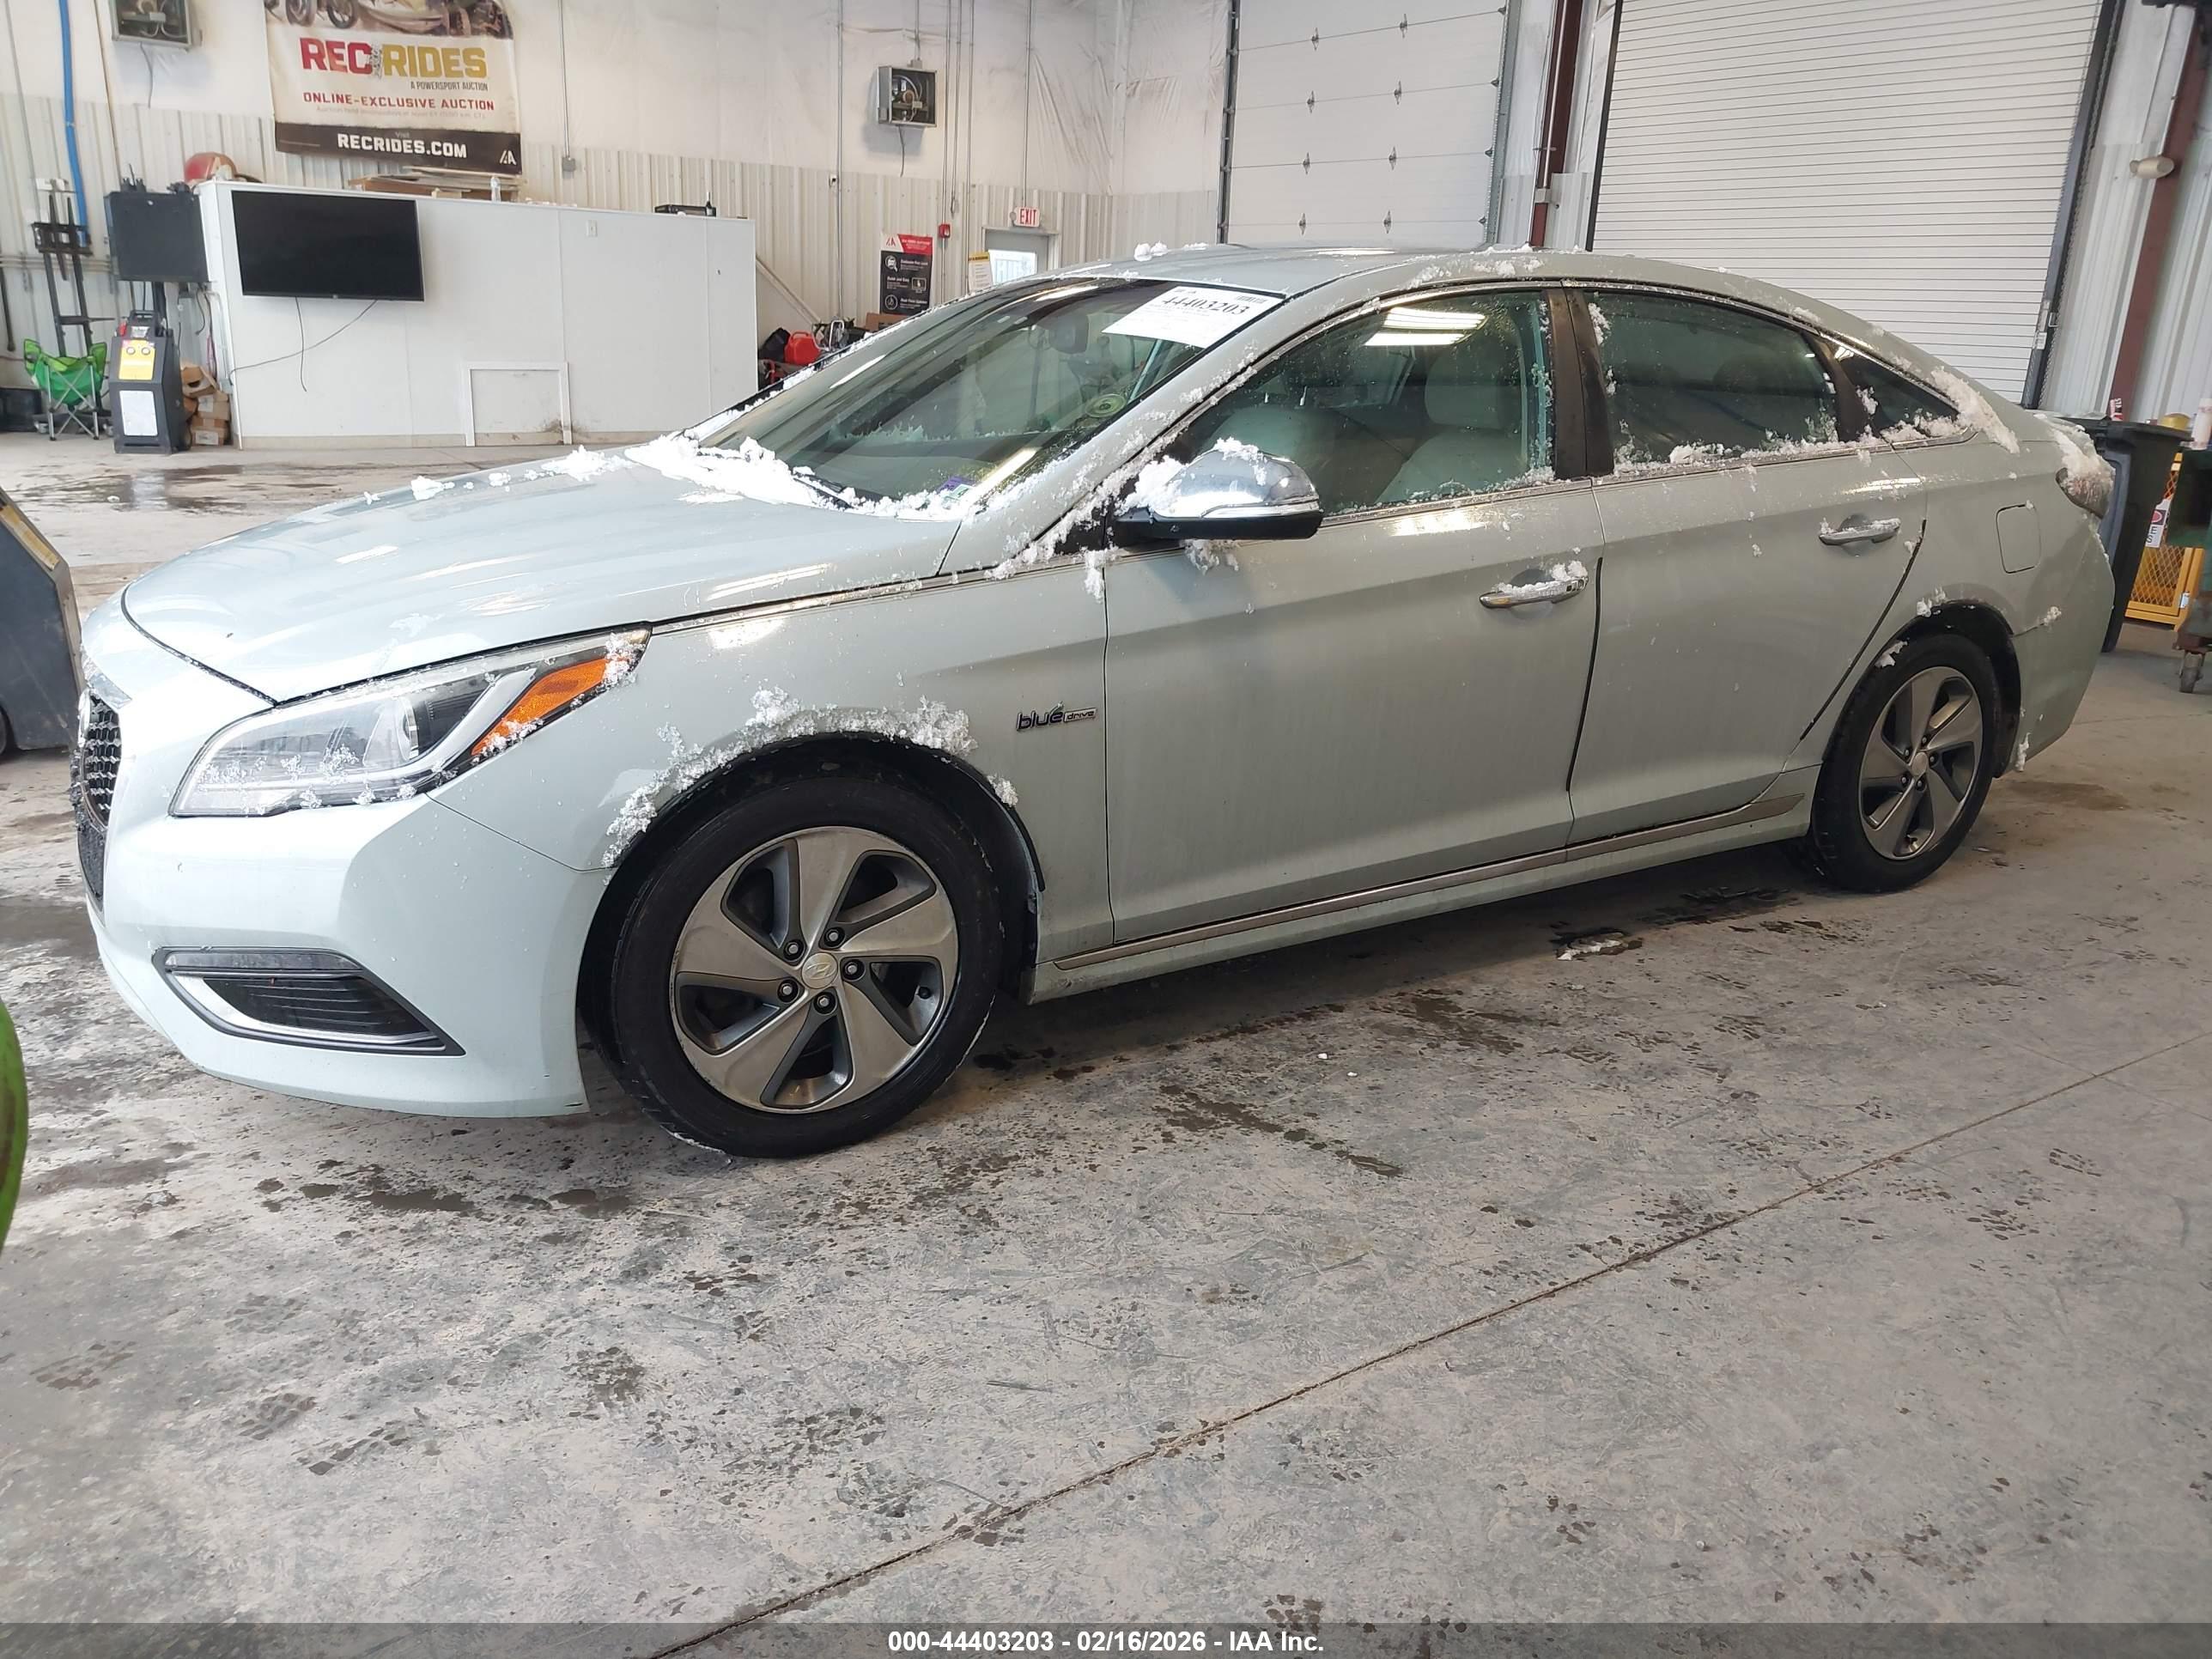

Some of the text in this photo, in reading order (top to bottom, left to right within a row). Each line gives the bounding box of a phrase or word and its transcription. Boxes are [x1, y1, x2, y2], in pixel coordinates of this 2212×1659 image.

[300, 37, 488, 79] REC RIDES
[410, 81, 489, 91] A POWERSPORT AUCTION
[303, 92, 495, 111] ONLINE-EXCLUSIVE AUCTION
[337, 133, 467, 158] RECRIDES.COM
[1019, 209, 1037, 225] EXIT
[1162, 296, 1250, 315] 44403203
[1066, 710, 1095, 720] drive
